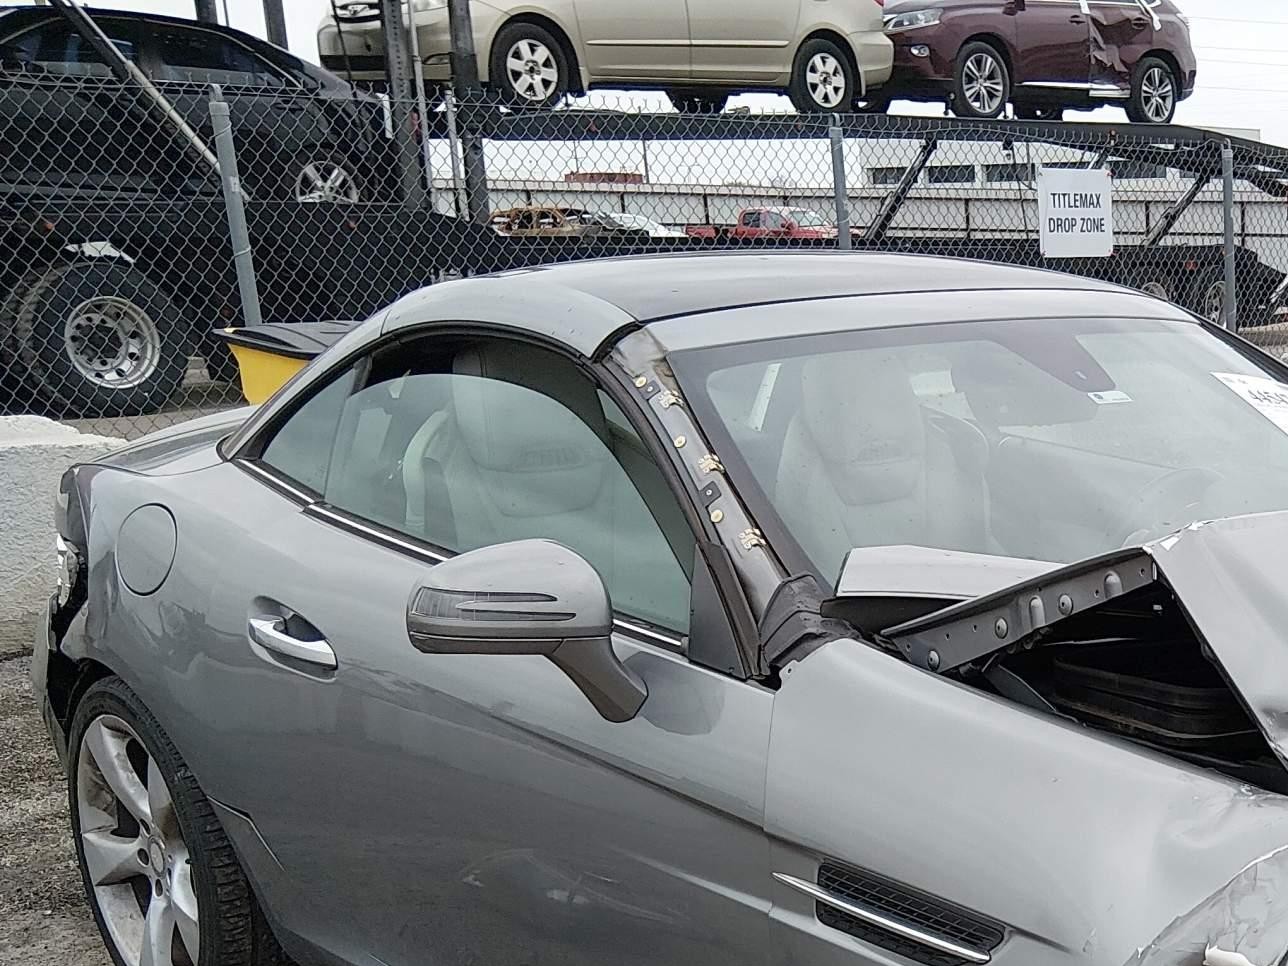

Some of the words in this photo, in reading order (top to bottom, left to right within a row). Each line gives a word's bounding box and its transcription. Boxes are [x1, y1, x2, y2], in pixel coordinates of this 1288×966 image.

[1050, 192, 1102, 208] TITLEMAX
[1048, 217, 1077, 232] DROP
[1080, 217, 1105, 232] ZONE
